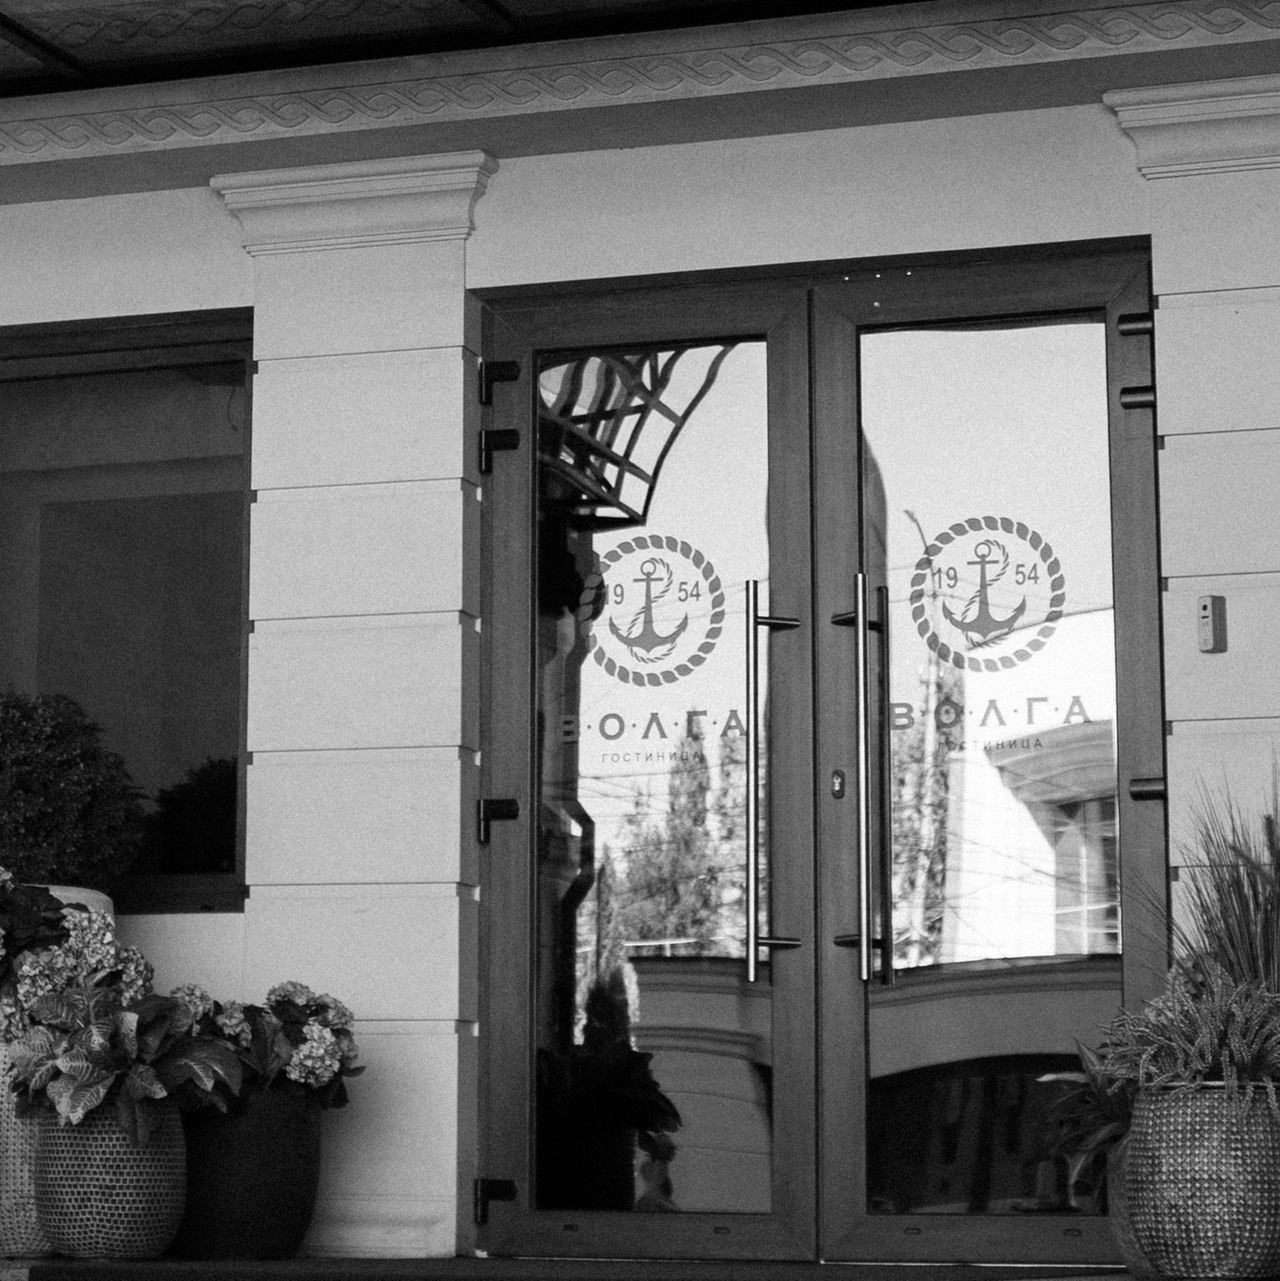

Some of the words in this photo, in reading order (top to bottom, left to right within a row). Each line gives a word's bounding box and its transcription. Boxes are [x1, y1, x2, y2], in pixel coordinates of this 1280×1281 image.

[933, 567, 958, 589] 19
[1015, 563, 1039, 585] 54
[678, 580, 701, 602] 54
[601, 750, 702, 764] ГОСТИНИЦА
